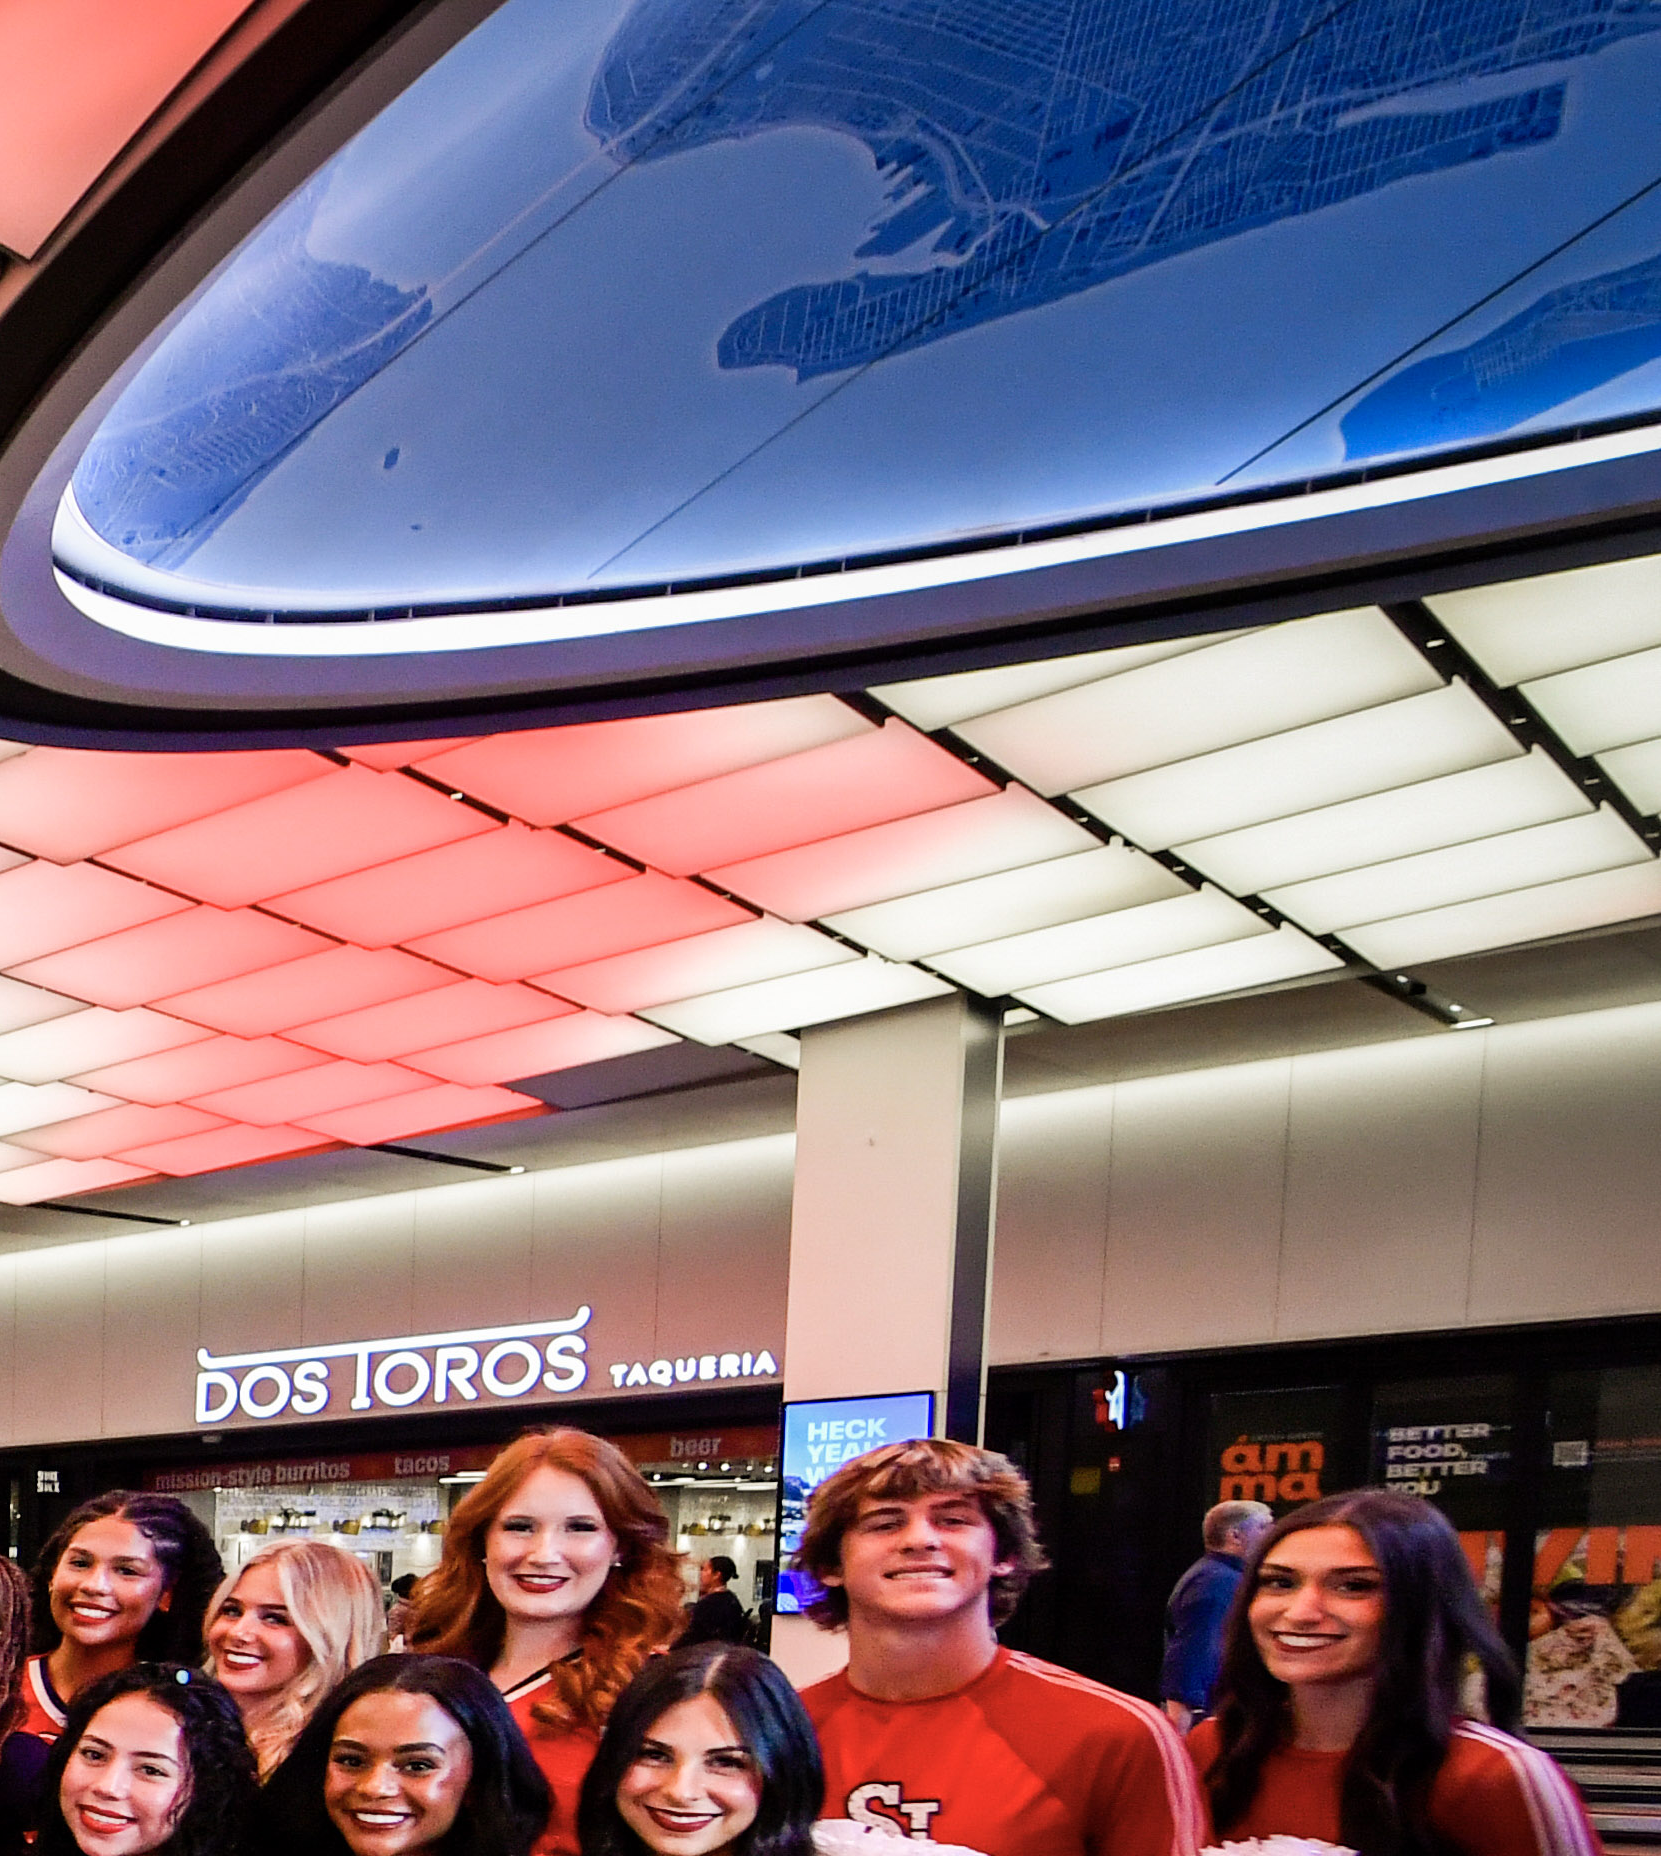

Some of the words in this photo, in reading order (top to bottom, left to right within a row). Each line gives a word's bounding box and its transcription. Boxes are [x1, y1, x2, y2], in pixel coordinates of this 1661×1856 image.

[194, 1360, 332, 1423] DOS
[348, 1334, 590, 1410] TOROS
[609, 1349, 778, 1389] TAQUERIA
[807, 1417, 887, 1442] HECK
[1388, 1423, 1490, 1442] BETTER
[669, 1436, 722, 1458] beer
[1387, 1443, 1469, 1460] FOOD,
[155, 1465, 271, 1489] mission-style
[274, 1460, 351, 1484] burritos
[394, 1455, 451, 1475] tacos
[1386, 1461, 1488, 1479] BETTER
